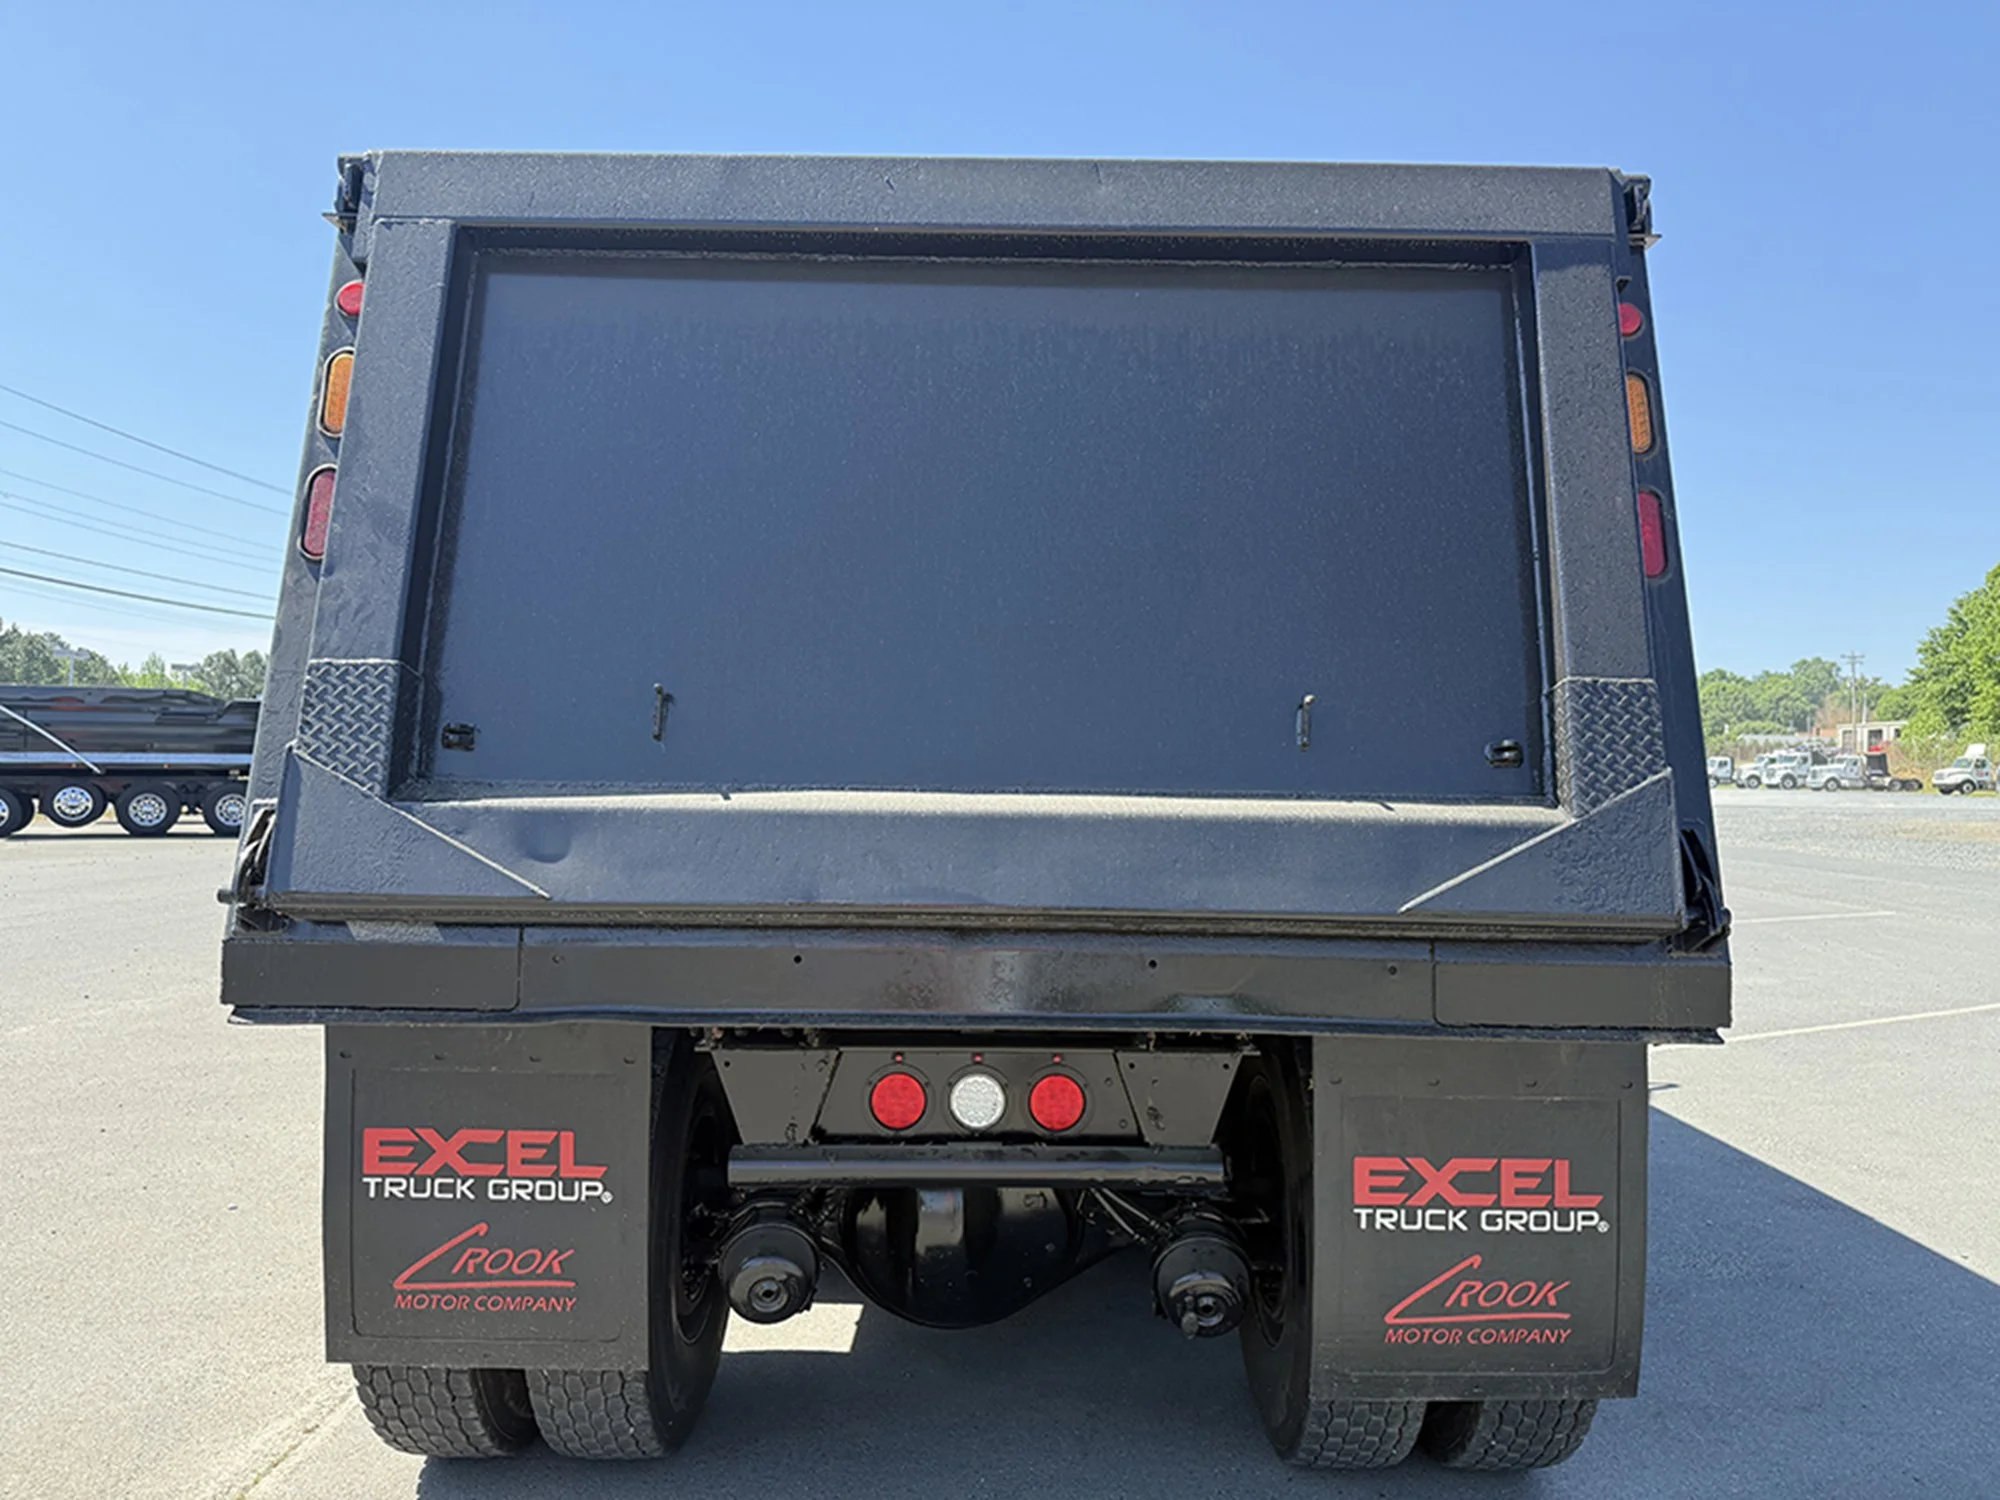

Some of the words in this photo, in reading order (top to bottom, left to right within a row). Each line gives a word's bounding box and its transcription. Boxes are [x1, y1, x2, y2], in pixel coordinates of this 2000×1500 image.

[362, 1127, 608, 1178] EXCEL
[362, 1177, 476, 1199] TRUCK
[1353, 1156, 1604, 1207] EXCEL
[1353, 1208, 1468, 1231] TRUCK
[394, 1294, 470, 1310] MOTOR
[473, 1295, 577, 1312] COMPANY
[1384, 1328, 1463, 1344] MOTOR
[1466, 1328, 1572, 1344] COMPANY
